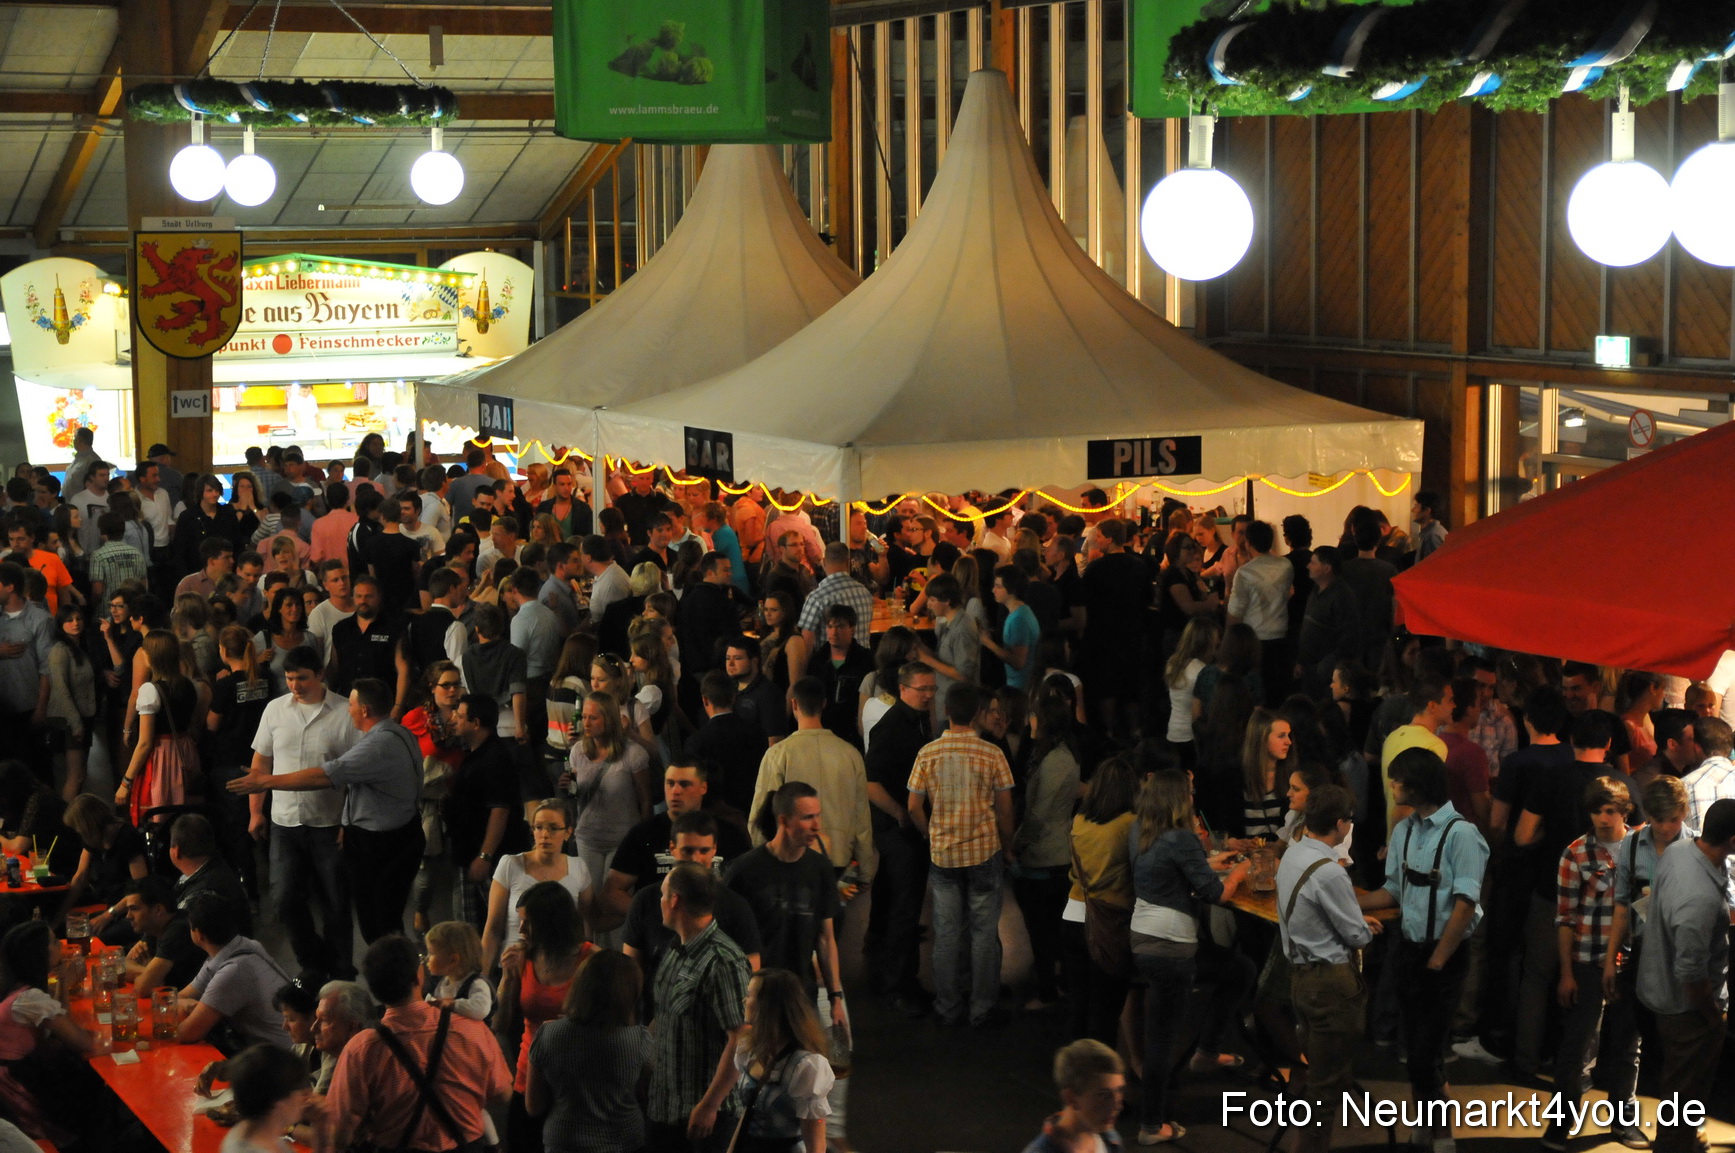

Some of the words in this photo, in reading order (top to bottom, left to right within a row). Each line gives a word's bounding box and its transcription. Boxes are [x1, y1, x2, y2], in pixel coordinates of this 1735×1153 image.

[608, 104, 719, 115] www.lammsbraeu.de
[161, 219, 182, 228] Stadt
[243, 279, 273, 291] axn
[276, 274, 361, 291] Liebermann
[264, 306, 302, 323] aus
[305, 292, 401, 324] Bayern
[299, 335, 421, 350] Feinschmecker
[180, 398, 201, 408] WC
[687, 436, 731, 473] BAR
[1113, 439, 1177, 477] PILS
